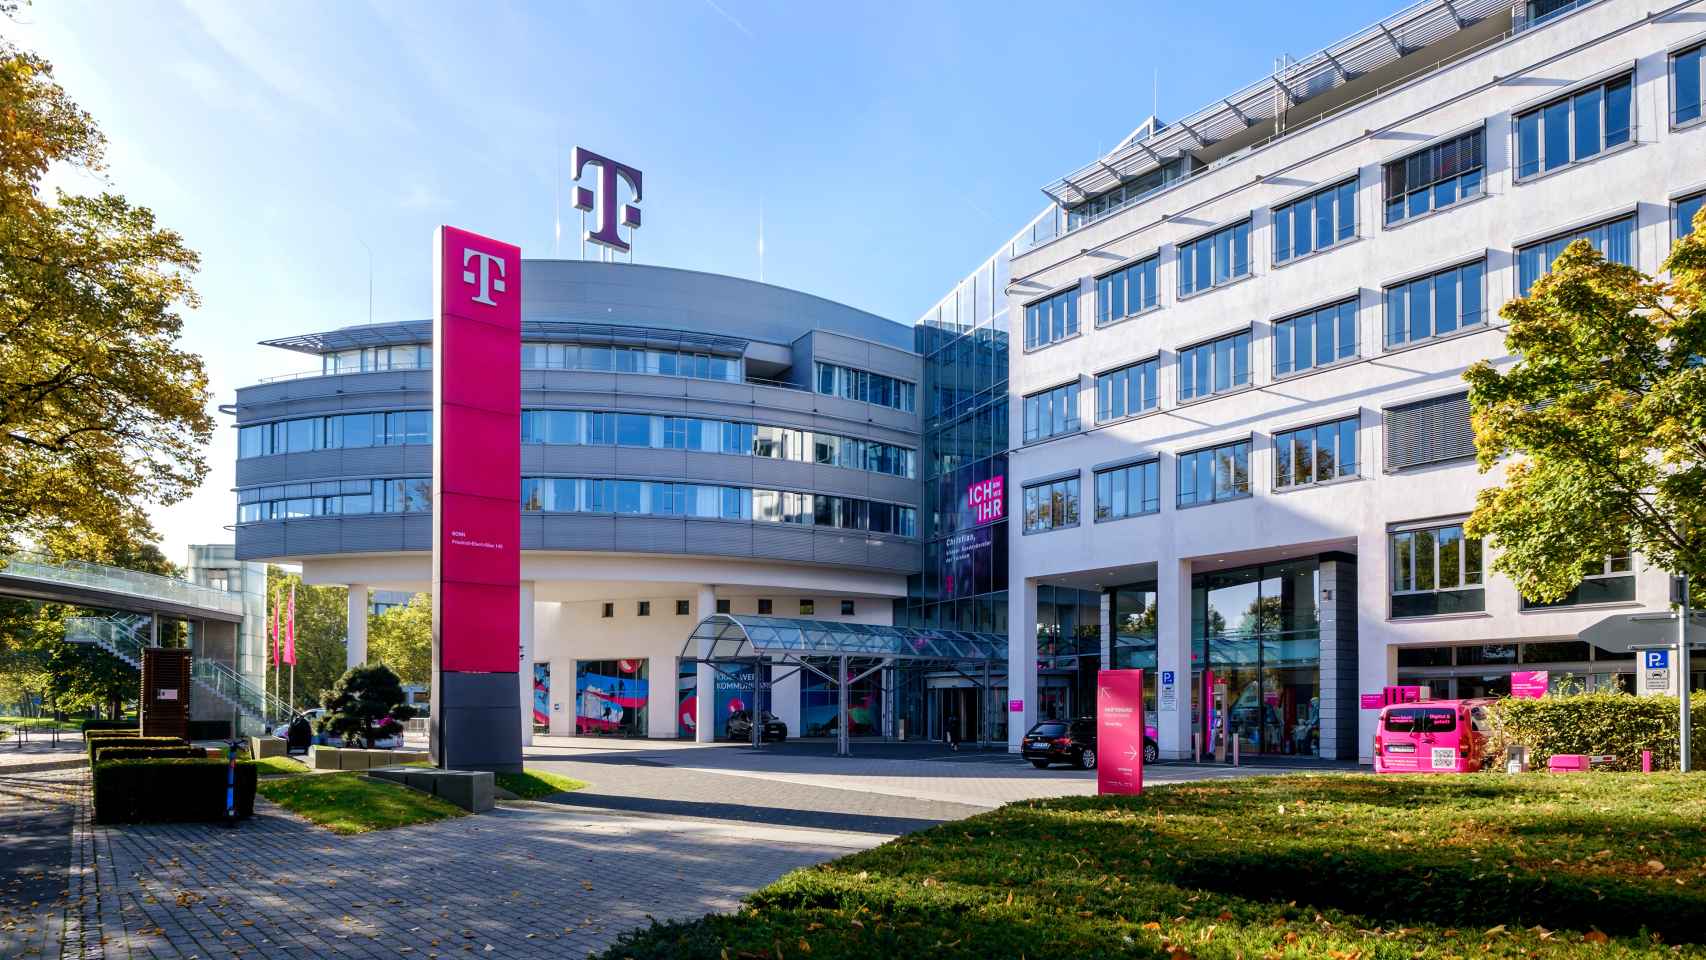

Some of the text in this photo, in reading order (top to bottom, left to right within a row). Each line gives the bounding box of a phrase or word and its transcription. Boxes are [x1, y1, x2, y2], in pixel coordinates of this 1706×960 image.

[570, 146, 643, 253] T
[463, 248, 506, 306] T
[969, 482, 992, 505] ICH
[978, 499, 1001, 521] IHR
[1648, 652, 1661, 667] P
[1163, 672, 1171, 683] P
